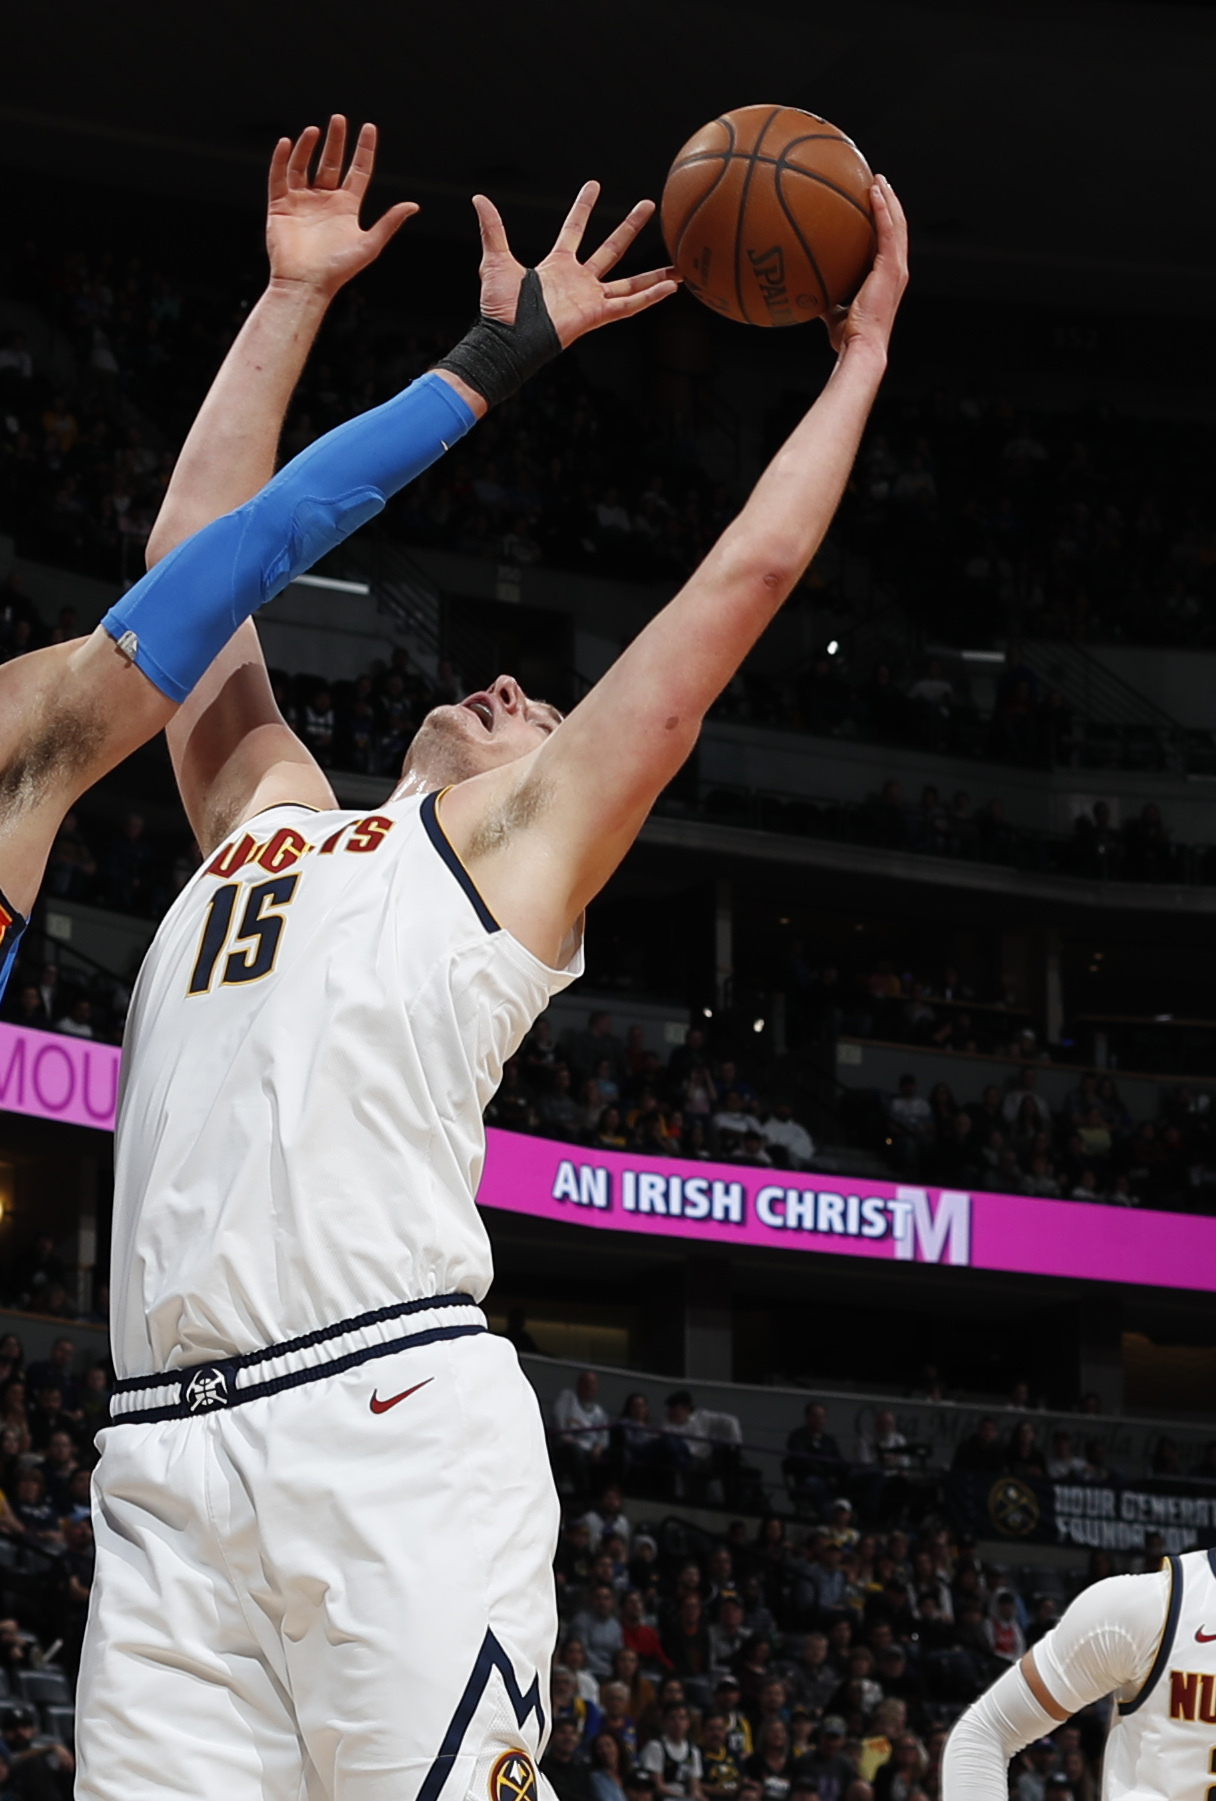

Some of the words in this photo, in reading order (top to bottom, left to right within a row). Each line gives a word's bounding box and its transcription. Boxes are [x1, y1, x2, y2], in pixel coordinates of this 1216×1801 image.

[187, 871, 303, 996] 15
[552, 1160, 609, 1209] AN
[622, 1170, 743, 1223] IRISH
